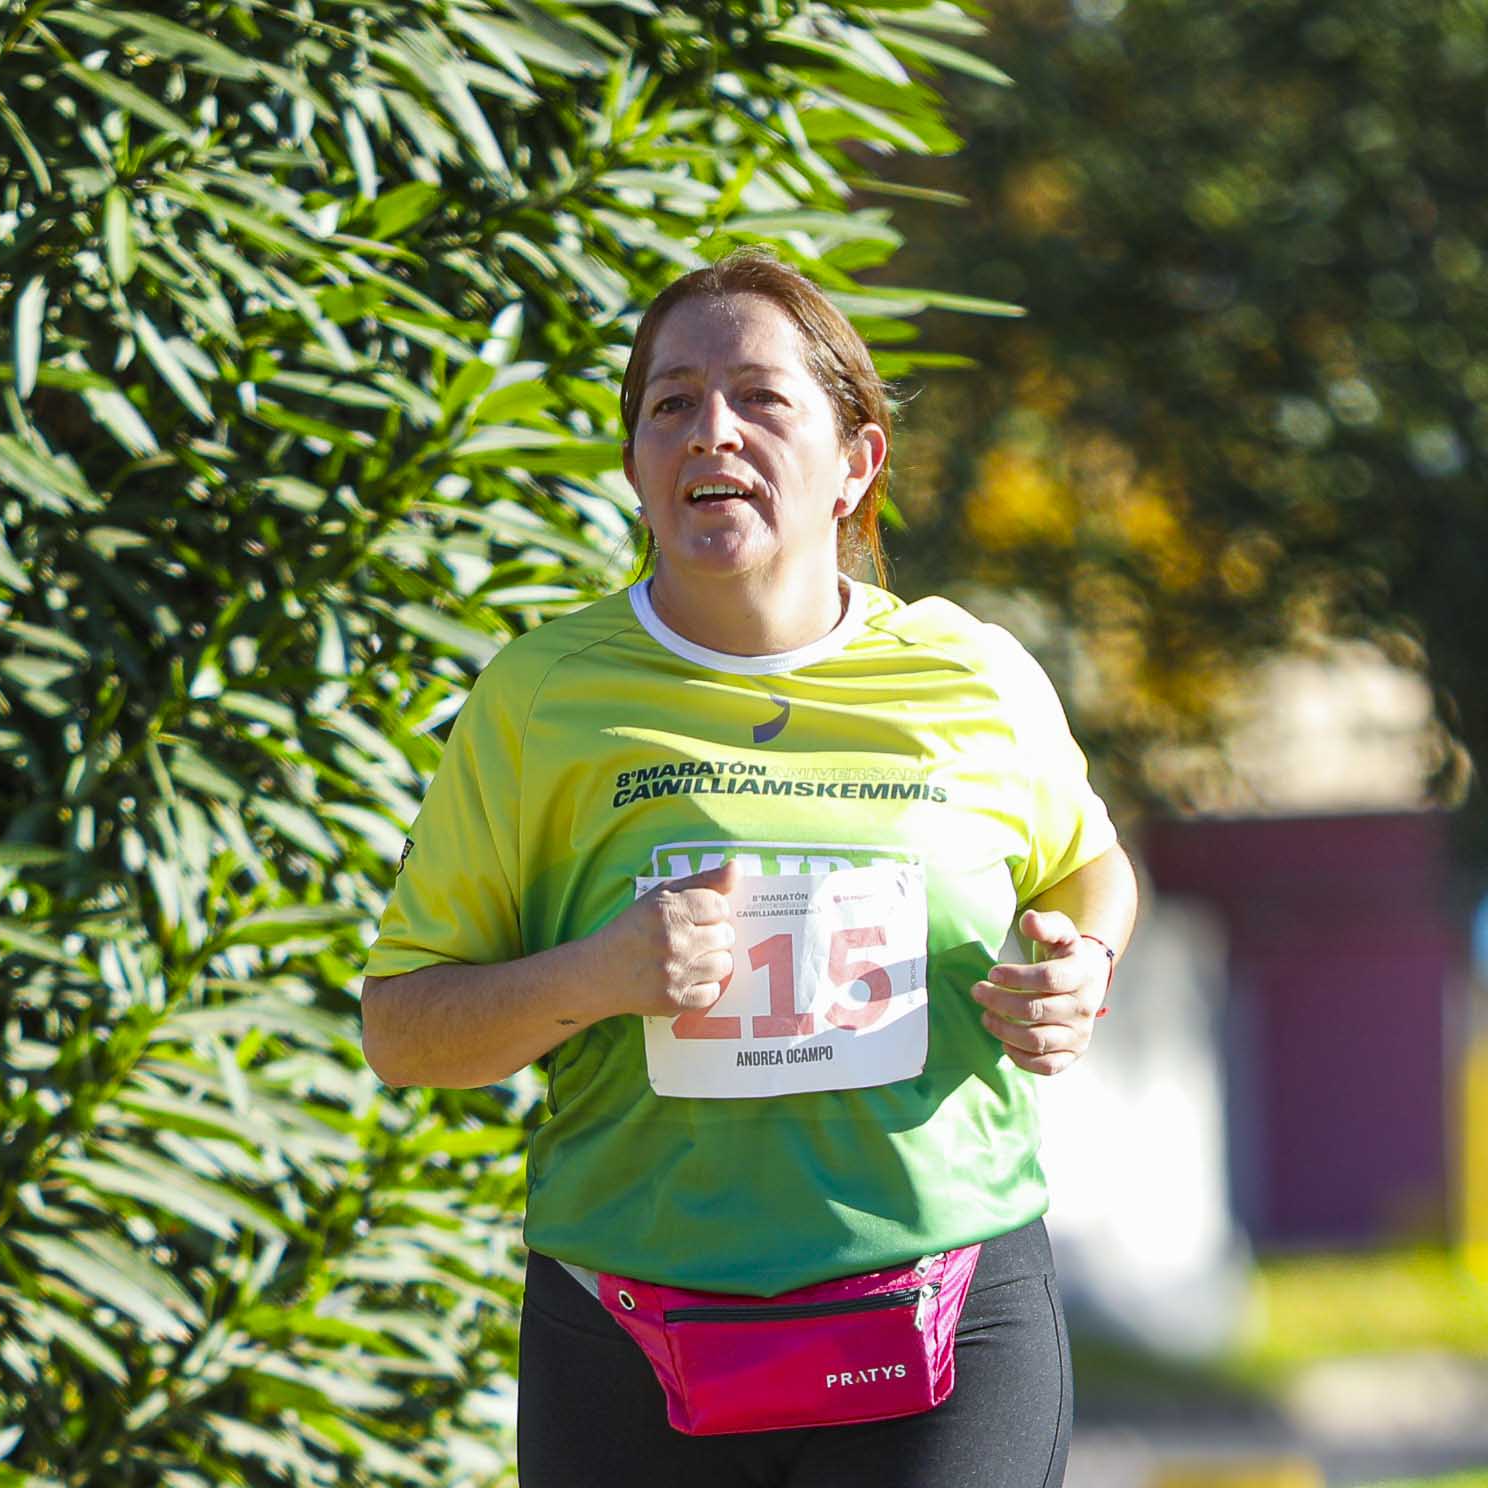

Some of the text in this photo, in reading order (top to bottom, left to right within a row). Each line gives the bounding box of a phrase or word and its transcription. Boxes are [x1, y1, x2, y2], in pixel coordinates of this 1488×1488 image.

[769, 767, 929, 782] ANIVERSARI
[612, 777, 947, 809] CAWILLIAMSKEMMIS
[735, 1044, 834, 1067] ANDREA OCAMPO
[825, 1364, 907, 1389] PRATYS
